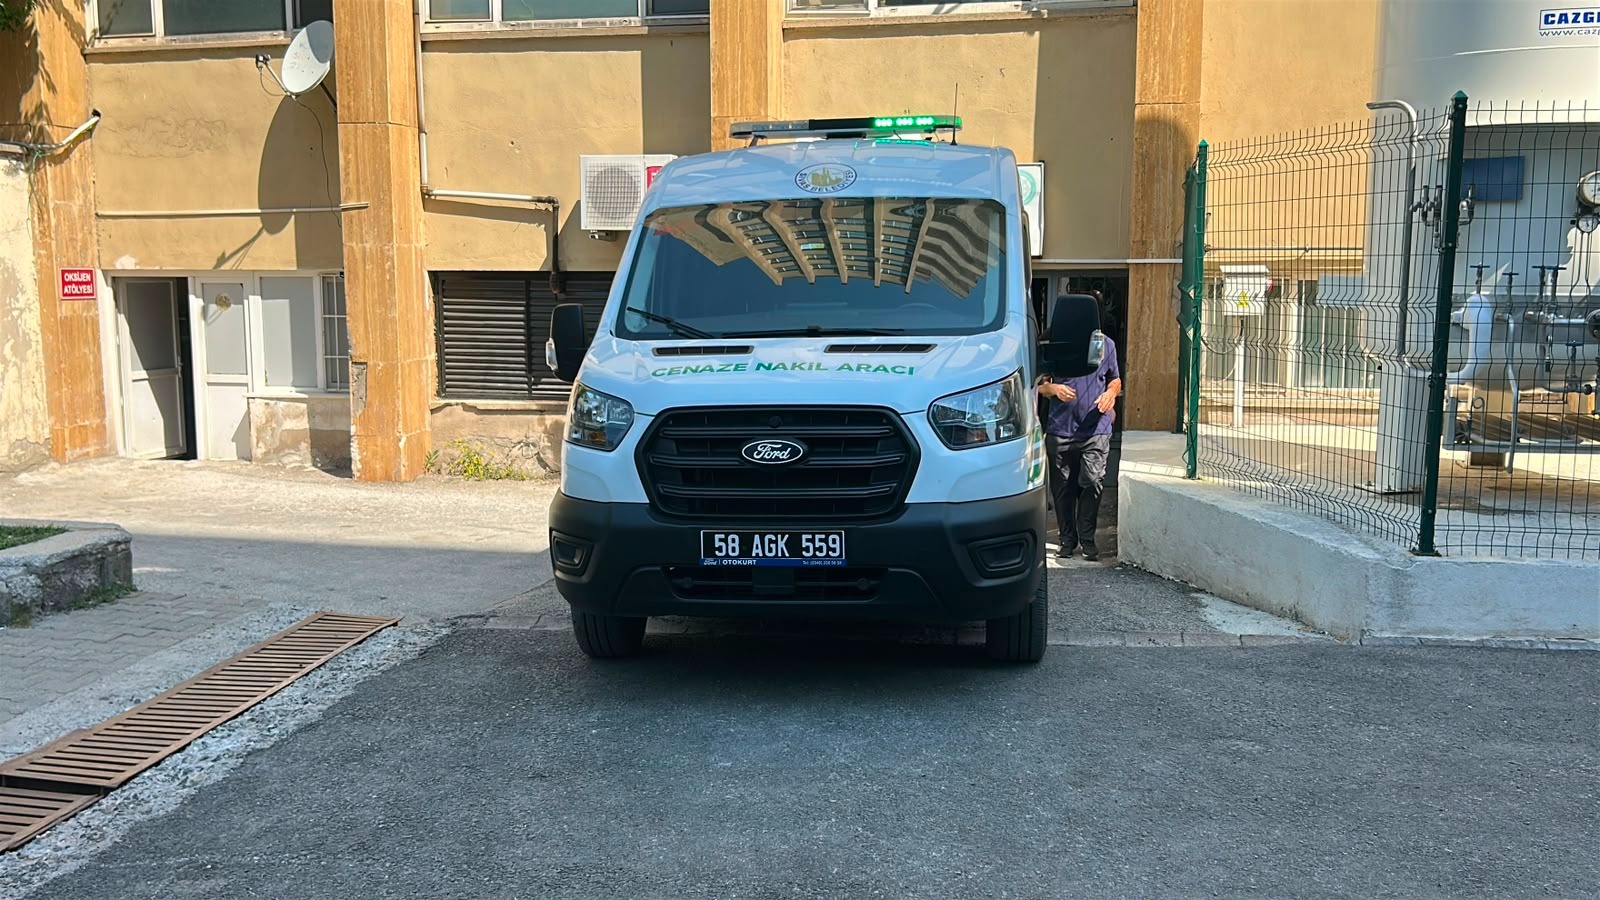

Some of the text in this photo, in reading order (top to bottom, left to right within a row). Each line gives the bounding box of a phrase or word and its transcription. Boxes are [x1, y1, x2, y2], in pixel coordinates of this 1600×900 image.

[64, 271, 92, 282] OKSİJEN
[64, 283, 93, 294] ATÖLYESİ
[651, 362, 749, 377] CENAZE
[836, 362, 916, 376] ARACI
[753, 443, 792, 459] Ford
[714, 534, 840, 557] 58 AGK 559
